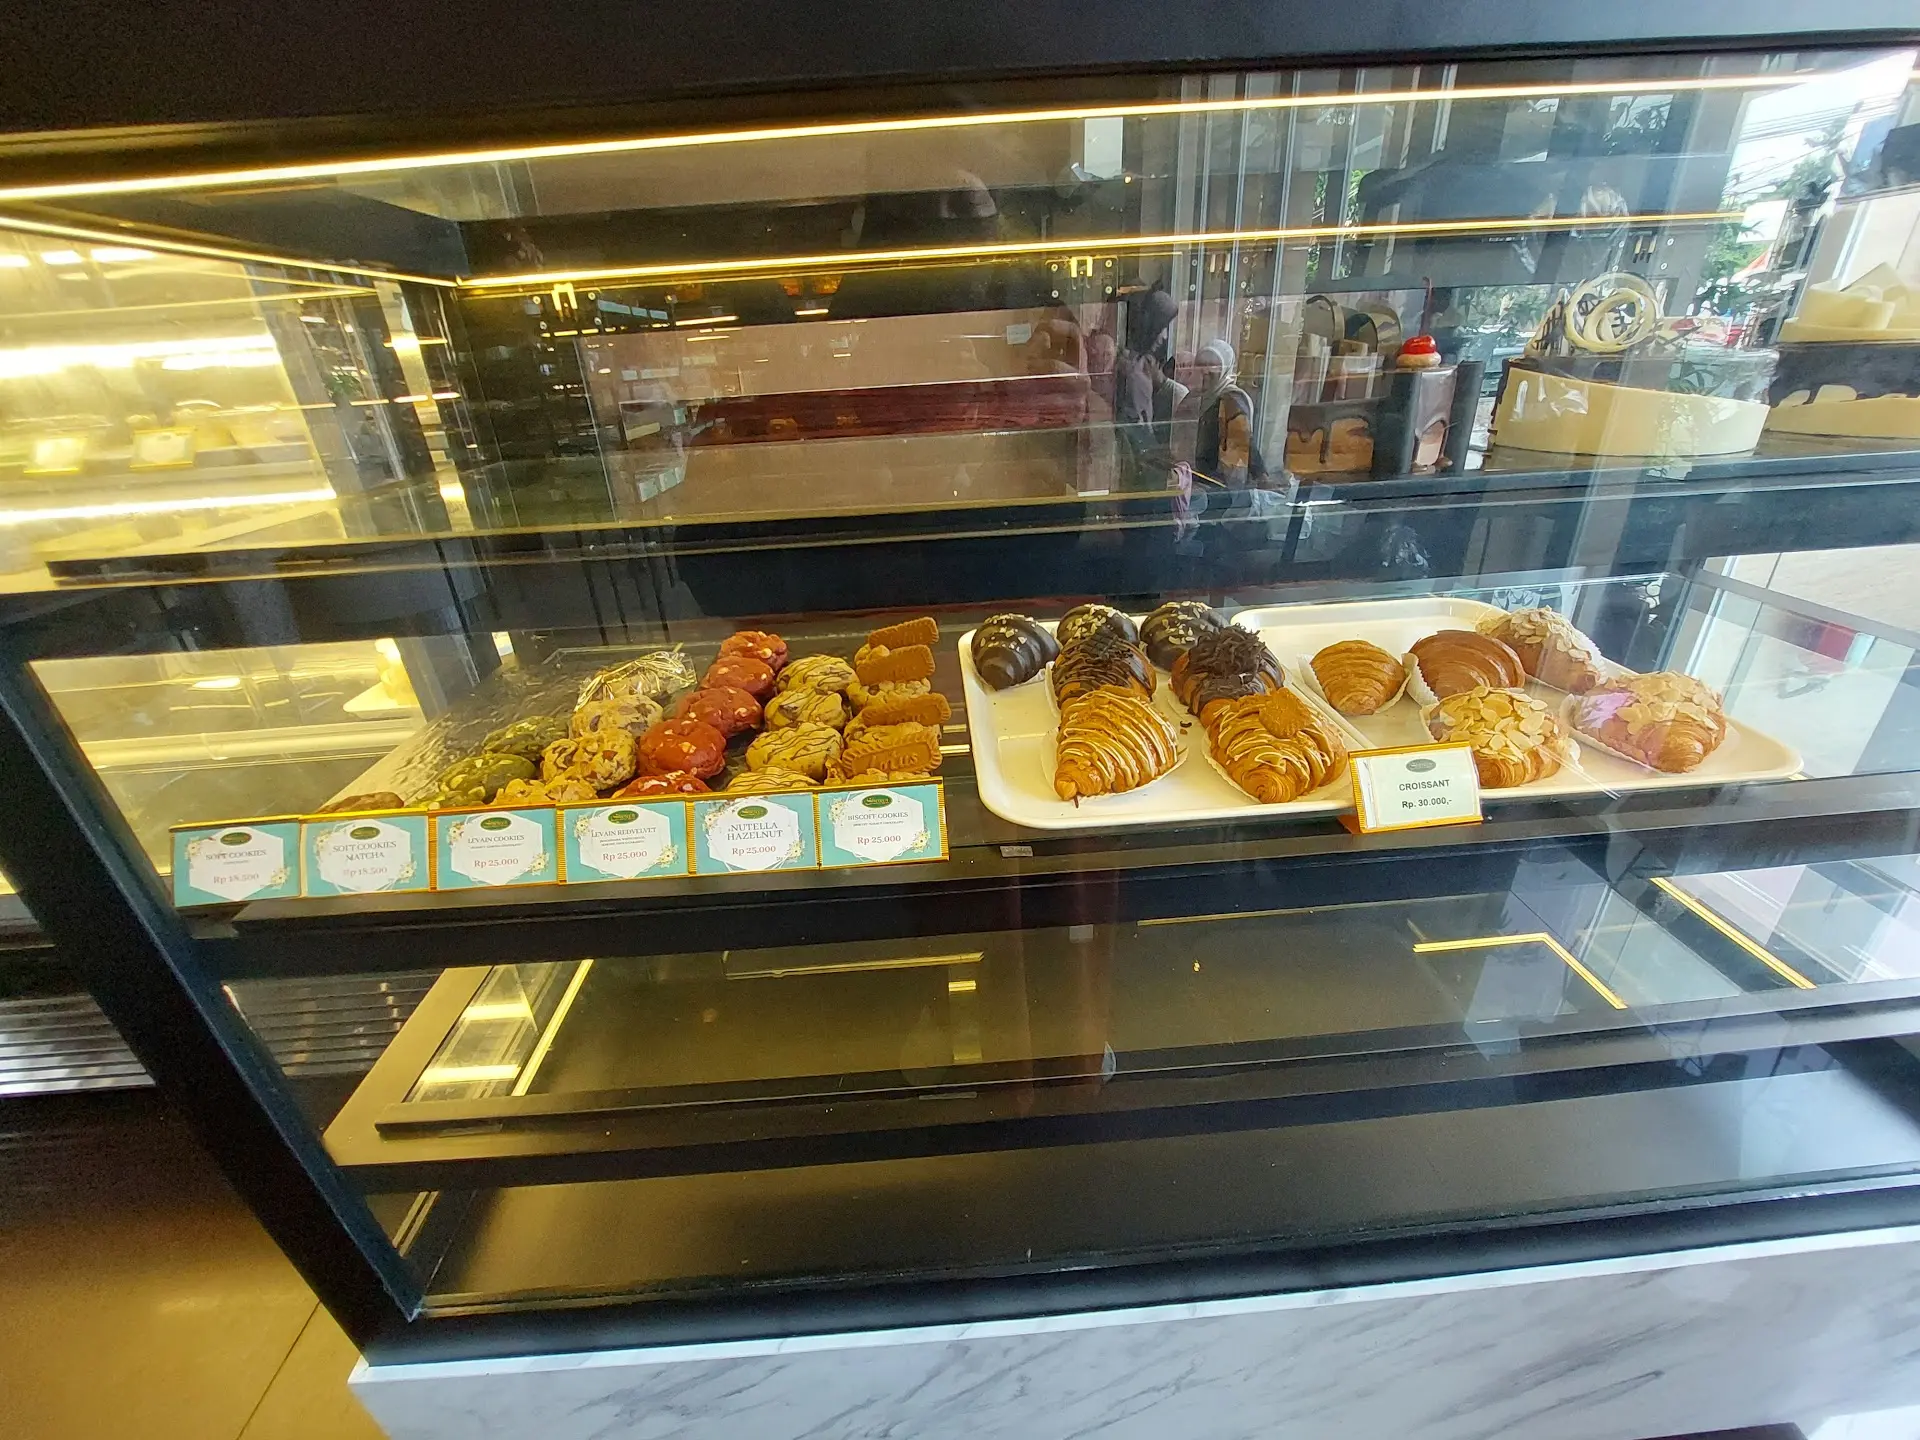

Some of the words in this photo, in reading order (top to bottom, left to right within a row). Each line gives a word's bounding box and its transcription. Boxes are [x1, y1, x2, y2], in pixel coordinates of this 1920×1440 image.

[1399, 779, 1449, 791] CROISSANT
[1402, 801, 1416, 809] Rp.
[1418, 797, 1452, 806] 30.000,-
[848, 813, 876, 821] BISCOFF
[877, 811, 909, 819] COOKIES
[591, 830, 616, 838] LEVAIN
[617, 827, 656, 836] REDVELVET
[730, 822, 778, 832] NUTELLA
[468, 836, 492, 844] LEVAIN
[727, 830, 783, 841] HAZELNUT
[857, 836, 869, 845] Rp
[871, 835, 901, 844] 25.000
[333, 844, 355, 852] SOFT
[356, 841, 396, 850] COOKIES
[732, 847, 744, 856] Rp
[746, 845, 776, 855] 25.000
[205, 852, 227, 861] SOFT
[228, 849, 267, 859] COOKIES
[346, 852, 385, 862] MATCHA
[603, 853, 615, 862] Rp
[617, 850, 647, 860] 25.000
[474, 860, 486, 869] Rp
[489, 858, 519, 867] 25.000
[213, 875, 227, 885] Rp
